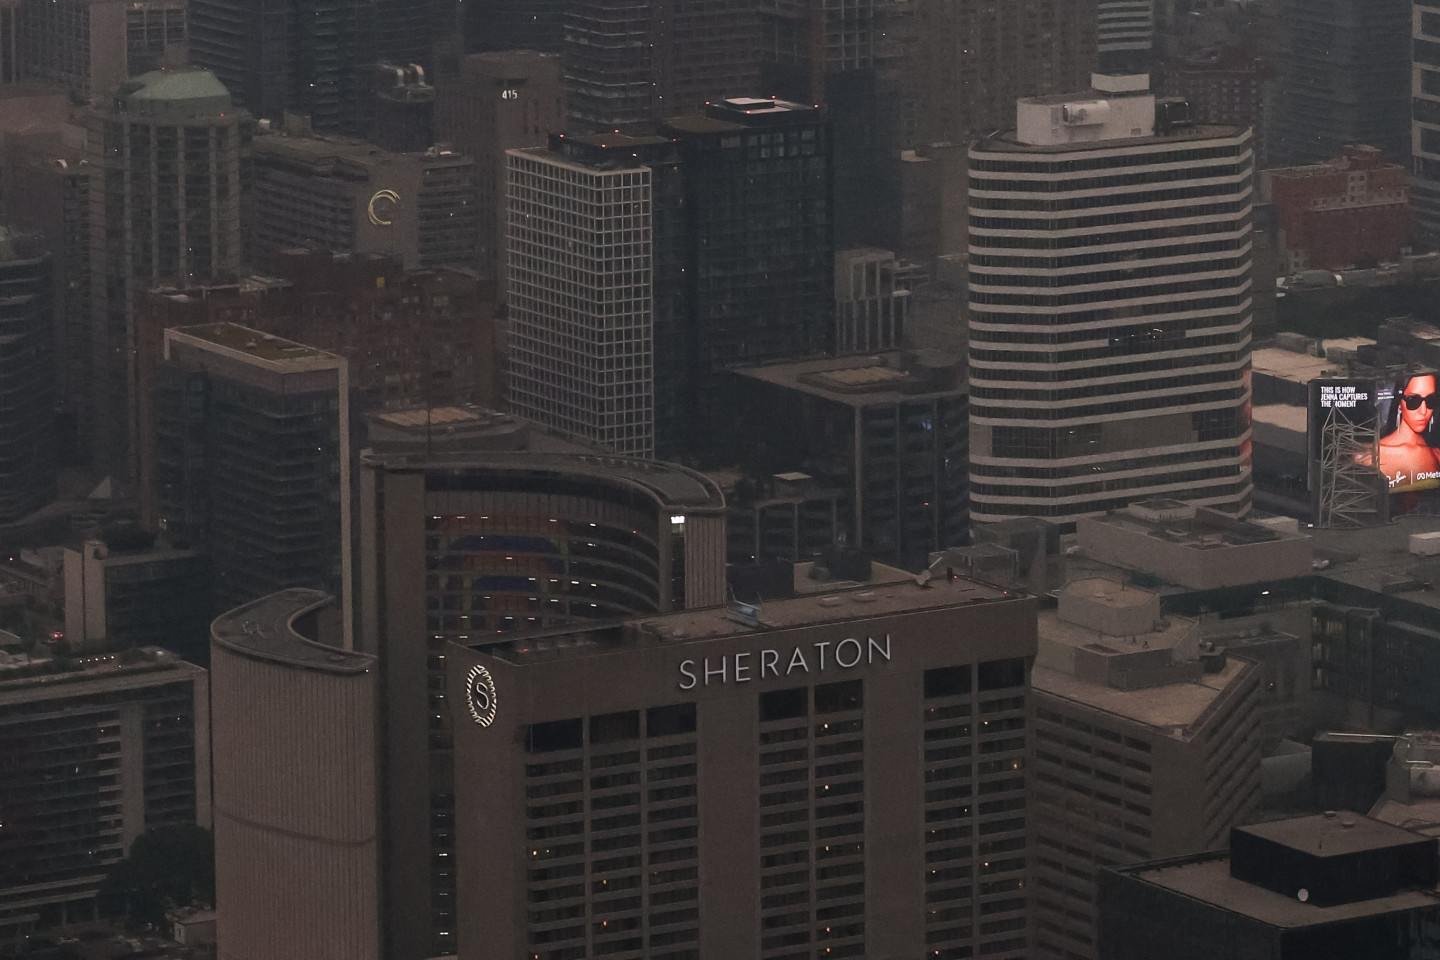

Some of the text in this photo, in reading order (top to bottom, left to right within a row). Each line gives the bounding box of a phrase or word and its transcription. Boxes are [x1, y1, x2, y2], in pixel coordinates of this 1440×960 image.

[502, 89, 518, 100] 415
[1320, 386, 1356, 394] THIS IS HOW
[1338, 392, 1368, 401] CAPTURES
[1321, 400, 1332, 408] THE
[679, 633, 892, 690] SHERATON
[476, 681, 489, 710] S
